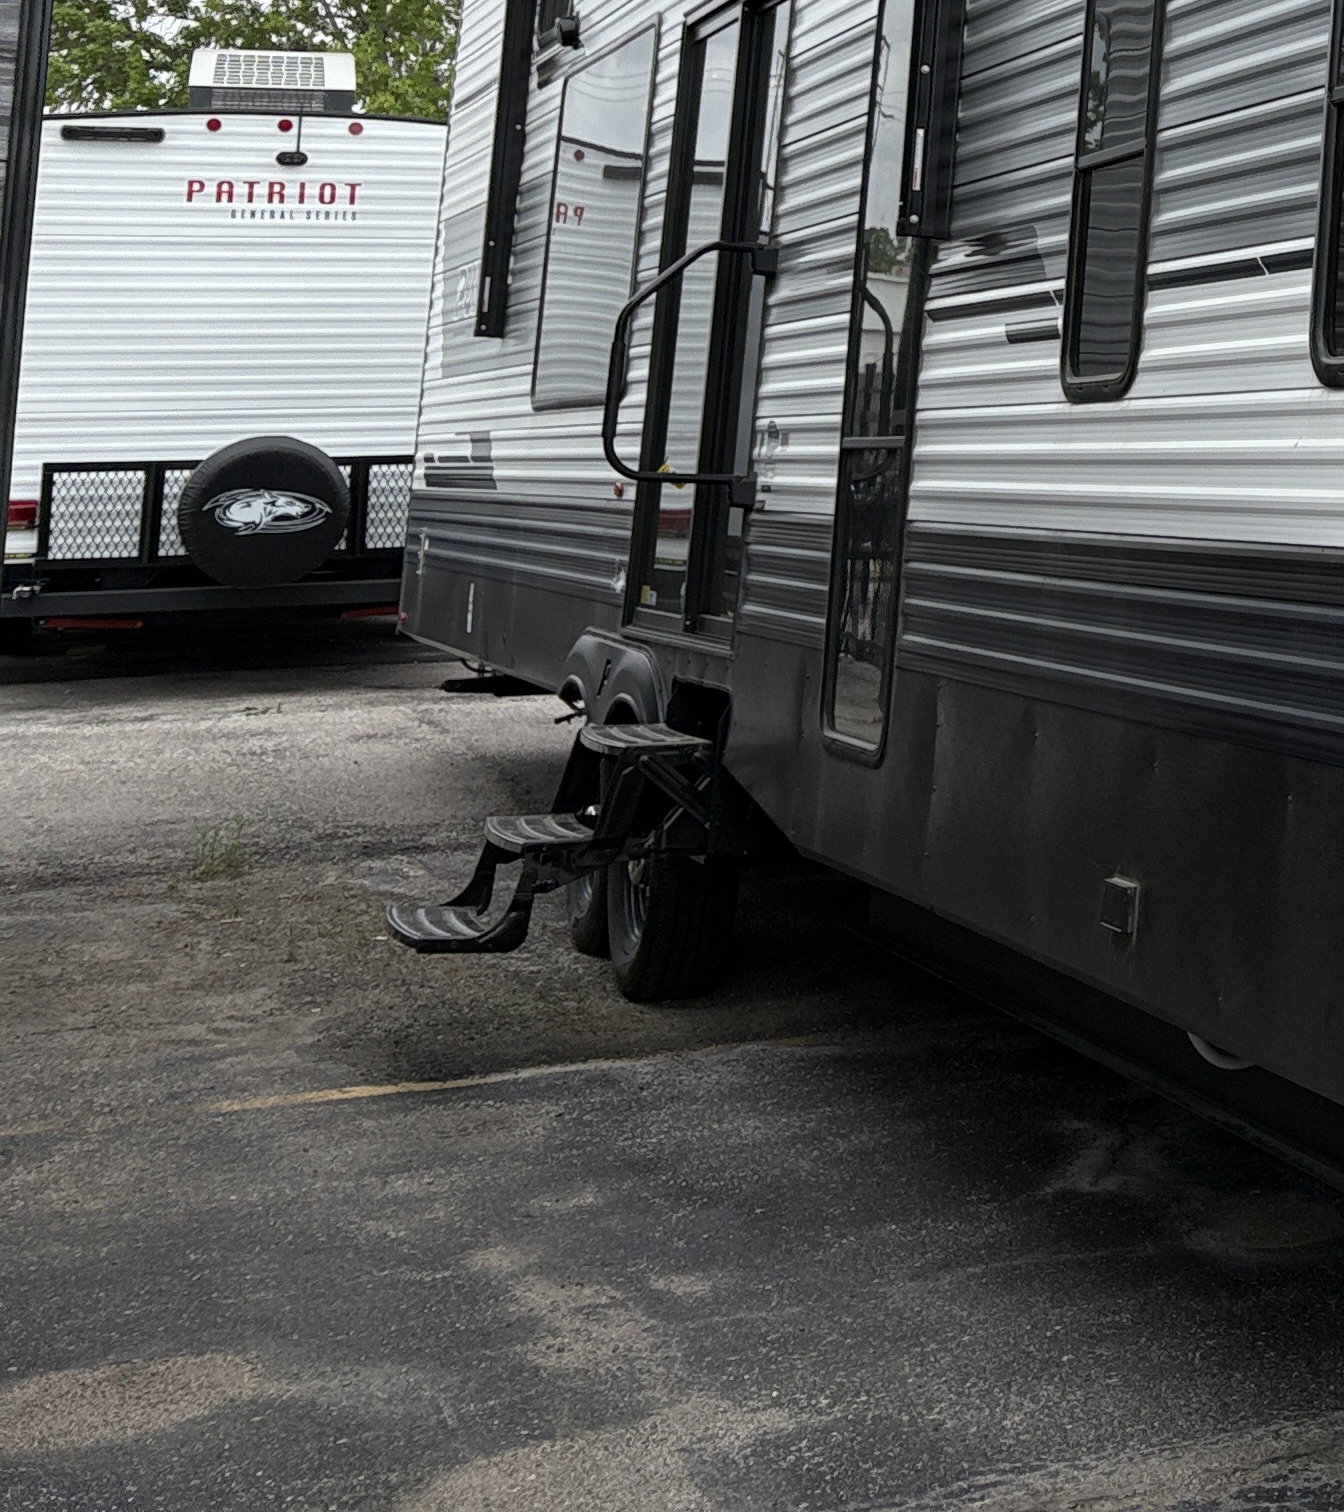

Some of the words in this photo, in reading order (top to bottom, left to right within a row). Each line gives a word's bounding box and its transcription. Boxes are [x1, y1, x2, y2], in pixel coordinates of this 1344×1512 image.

[186, 180, 362, 206] PATRIOT
[231, 209, 295, 221] GENERAL
[306, 210, 357, 221] SERIES
